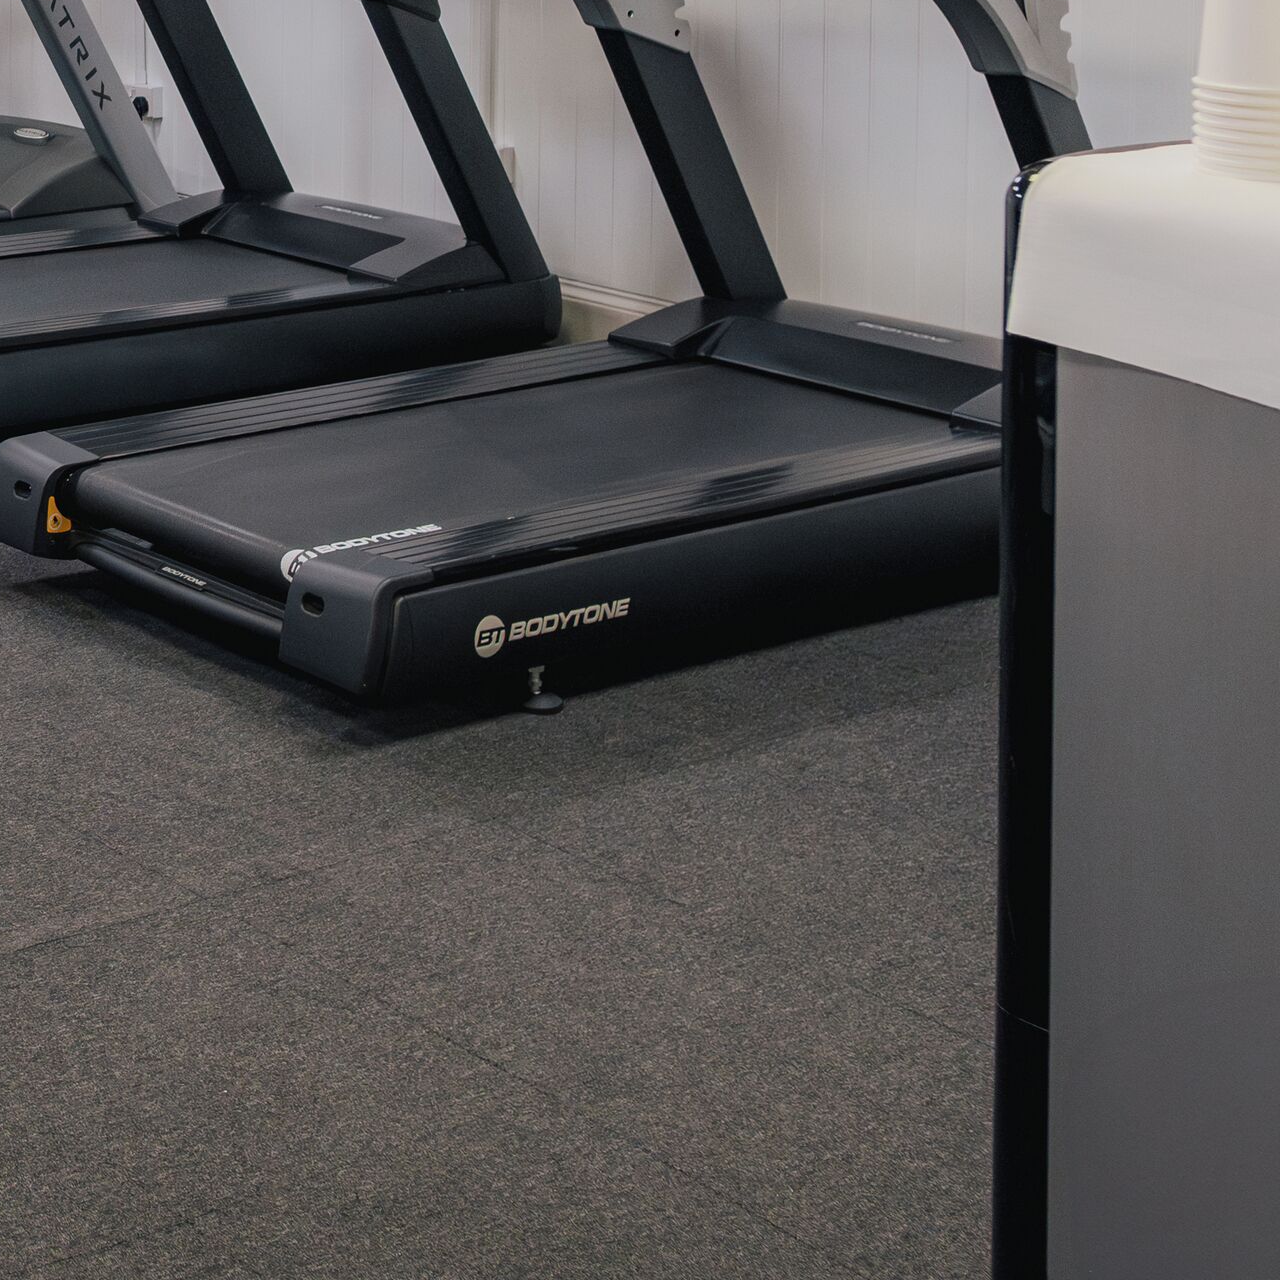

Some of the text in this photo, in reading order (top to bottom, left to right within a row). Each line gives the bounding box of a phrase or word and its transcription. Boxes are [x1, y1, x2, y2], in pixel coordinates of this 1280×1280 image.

[313, 523, 442, 554] BODYTONE
[161, 565, 208, 586] BODYTONE
[509, 597, 631, 641] BODYTONE
